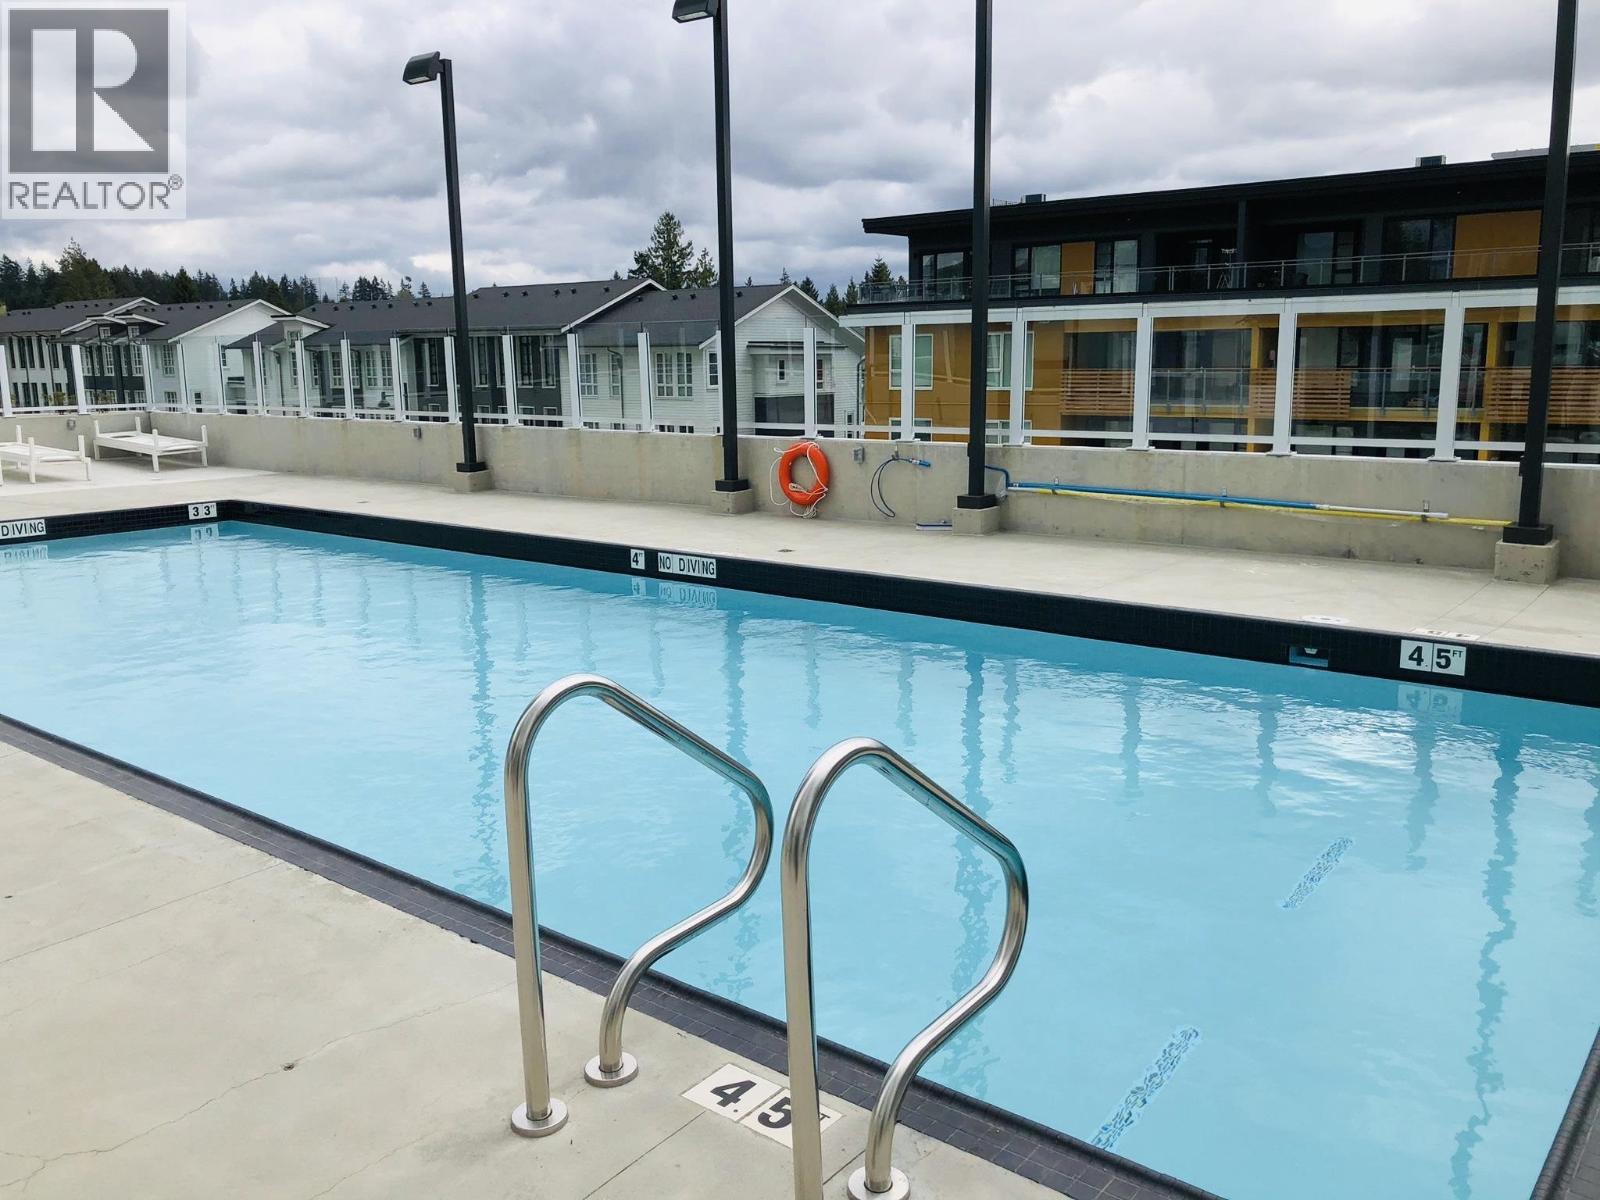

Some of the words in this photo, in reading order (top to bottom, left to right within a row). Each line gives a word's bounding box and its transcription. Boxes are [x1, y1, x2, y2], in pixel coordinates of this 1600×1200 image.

[1, 521, 45, 537] DIVING
[659, 554, 672, 570] NO
[678, 557, 715, 576] DIVING
